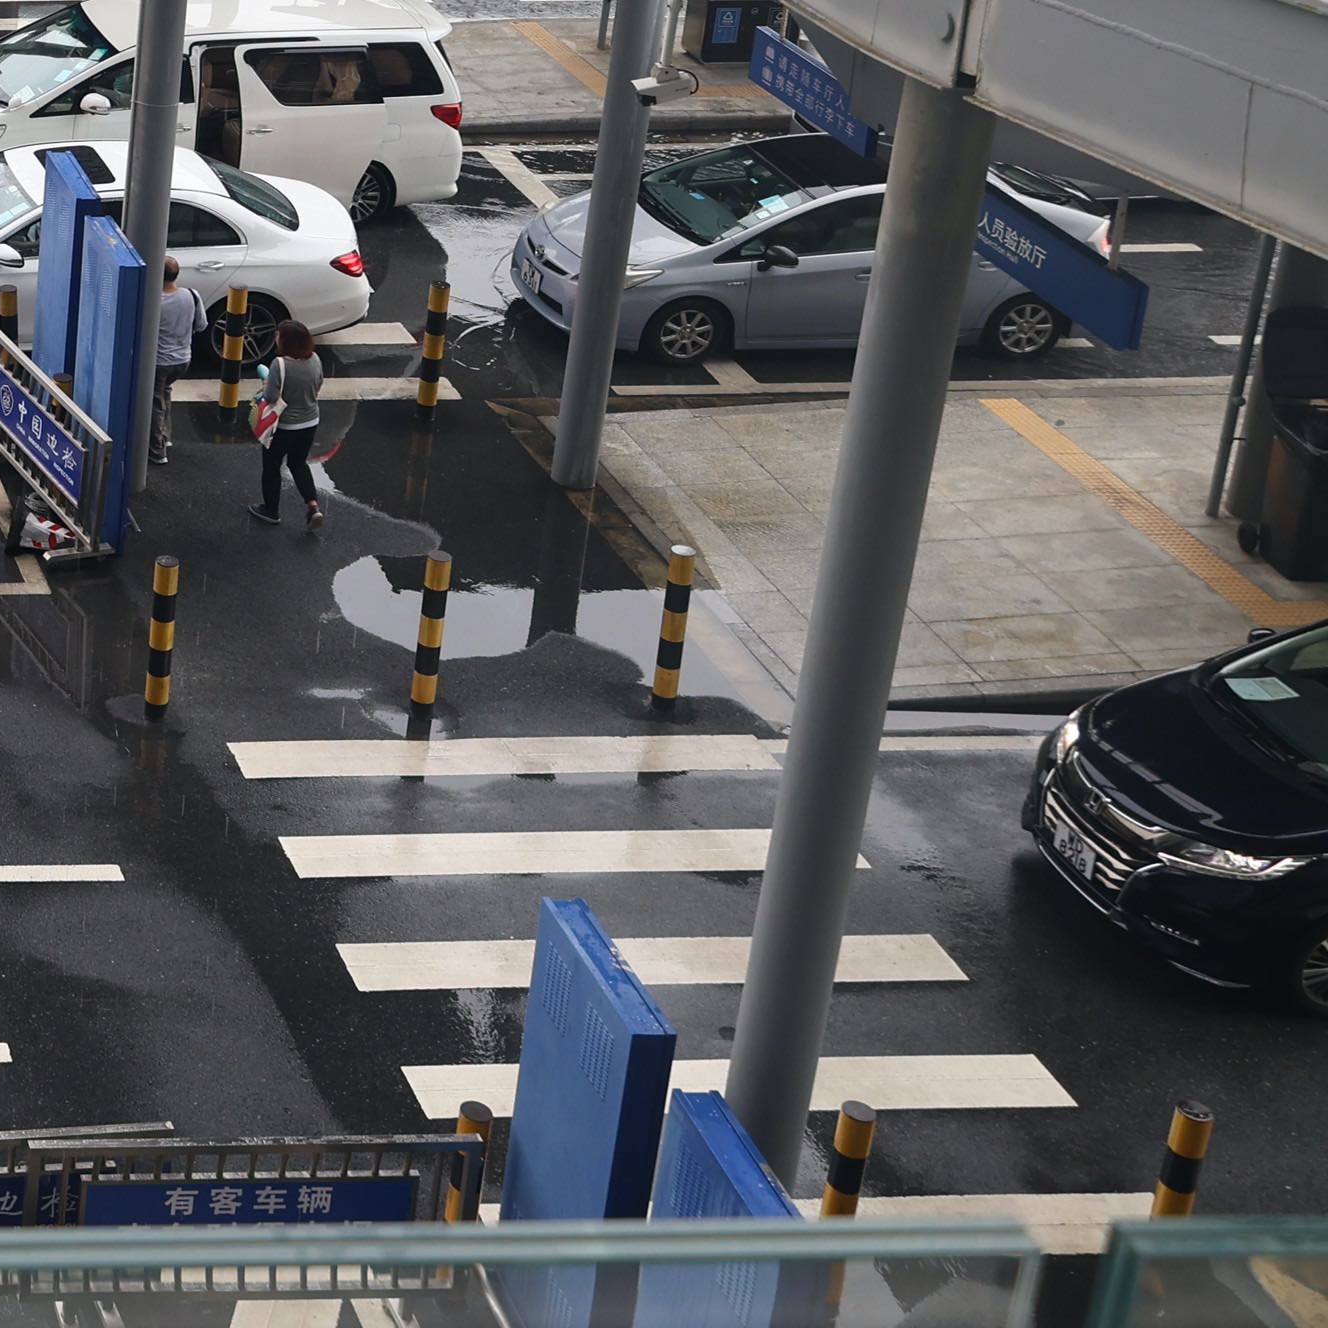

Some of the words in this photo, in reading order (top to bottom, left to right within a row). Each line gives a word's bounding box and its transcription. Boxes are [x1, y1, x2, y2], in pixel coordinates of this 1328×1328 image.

[977, 210, 1048, 270] 人员验放厅
[164, 1186, 333, 1217] 有客车辆
